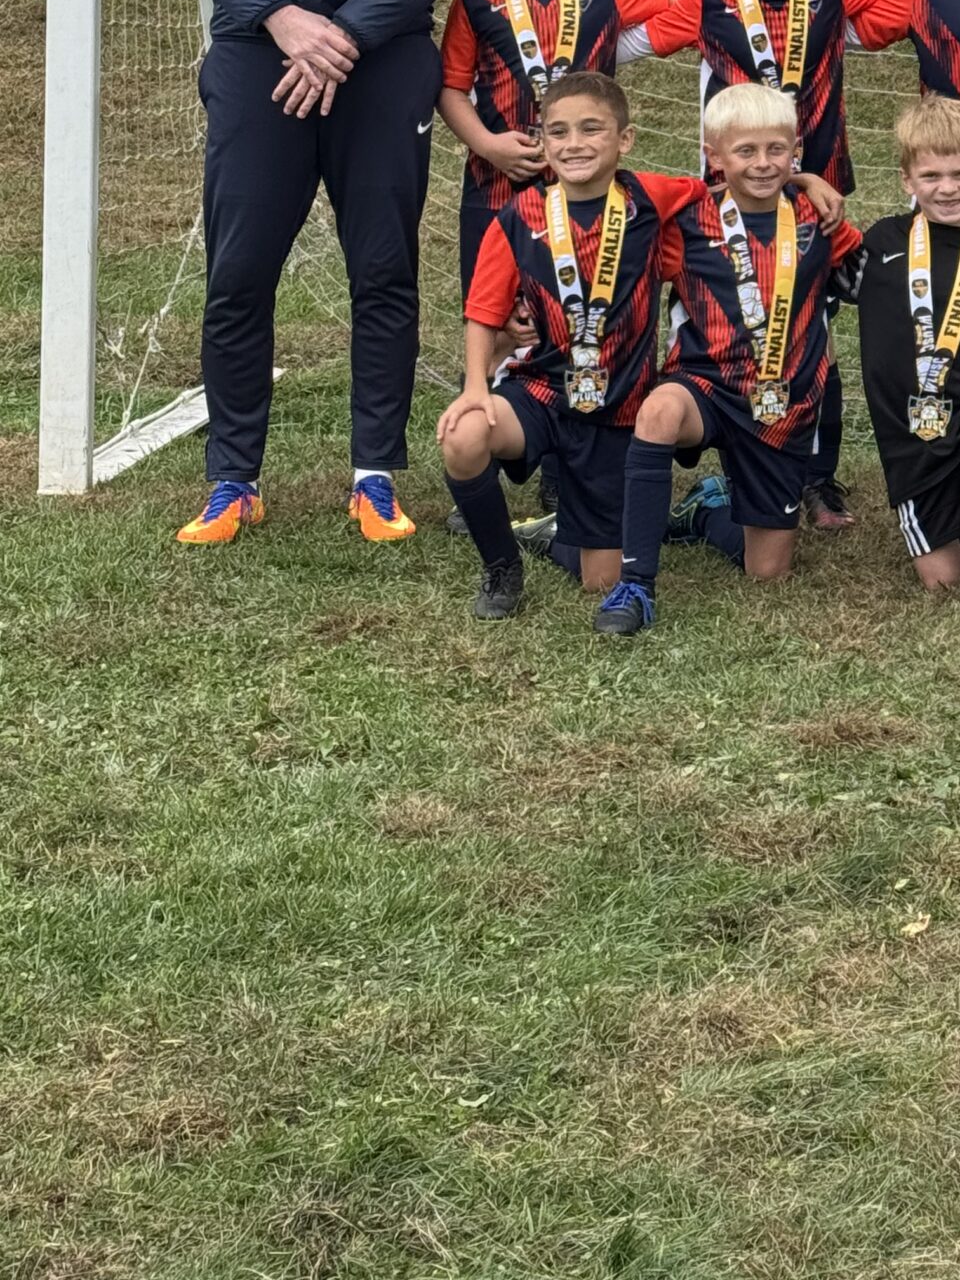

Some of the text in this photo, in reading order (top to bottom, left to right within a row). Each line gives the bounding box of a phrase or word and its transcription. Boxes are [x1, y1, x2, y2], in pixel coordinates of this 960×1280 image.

[597, 205, 623, 287] FINALIST
[765, 294, 789, 376] FINALIST
[569, 391, 605, 408] WLUSC
[753, 402, 787, 421] WLUSC
[909, 418, 947, 437] WLUSC
